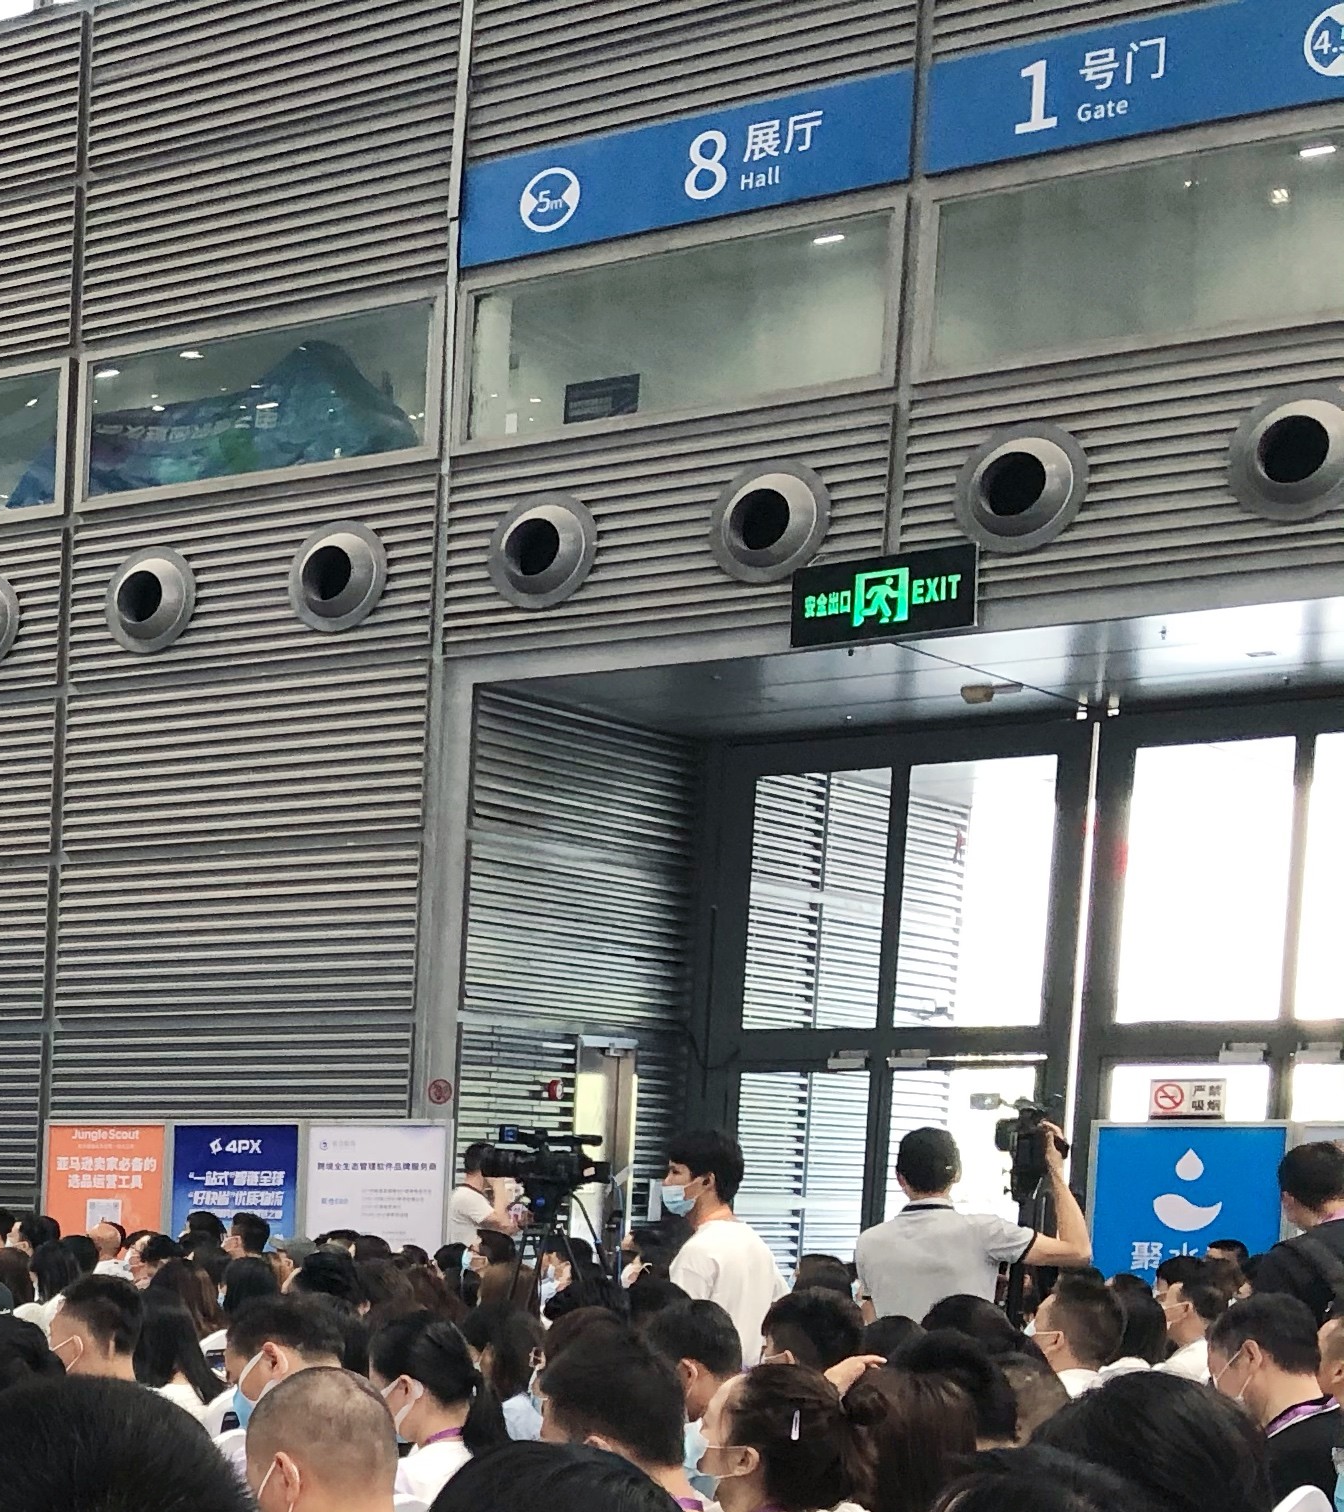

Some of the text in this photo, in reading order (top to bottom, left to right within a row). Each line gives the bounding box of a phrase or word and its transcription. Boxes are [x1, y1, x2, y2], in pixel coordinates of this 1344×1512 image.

[1014, 36, 1167, 135] 1 号门
[1077, 98, 1129, 123] Gate
[684, 110, 824, 200] 8 展厅
[740, 165, 780, 192] Hall
[536, 189, 563, 213] 5m
[804, 573, 962, 618] 安全出口 EXIT
[1191, 1085, 1223, 1097] 严禁
[1191, 1100, 1221, 1112] 吸烟
[72, 1129, 140, 1141] Jungle Scout
[225, 1139, 262, 1154] 4PX
